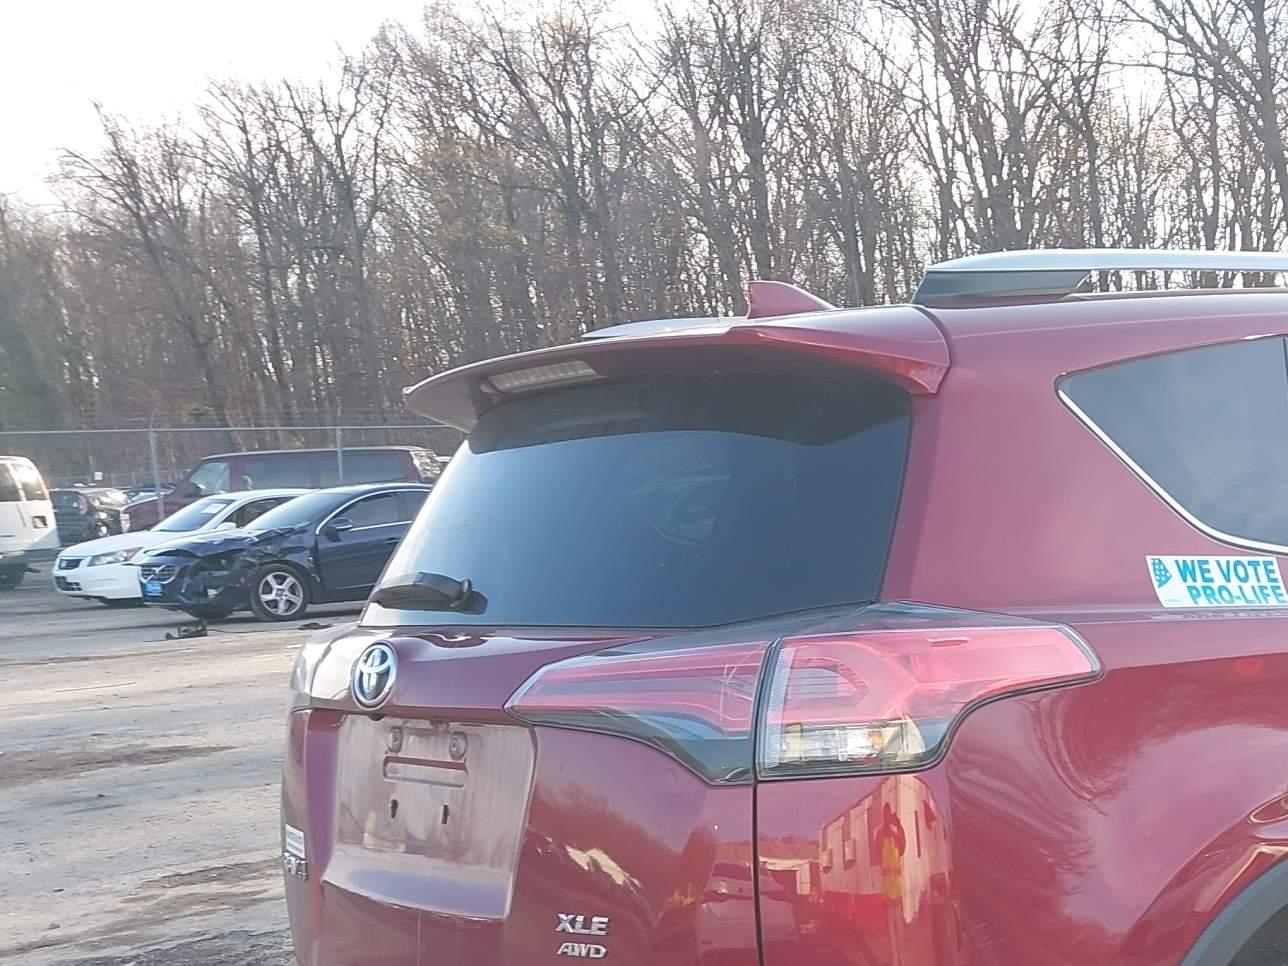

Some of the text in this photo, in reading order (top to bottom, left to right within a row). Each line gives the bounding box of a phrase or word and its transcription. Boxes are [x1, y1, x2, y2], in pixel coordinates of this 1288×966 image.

[1175, 559, 1280, 583] WE VOTE
[1186, 585, 1288, 605] PRO-LIFE
[555, 913, 609, 935] XLE
[557, 942, 607, 958] AWD
